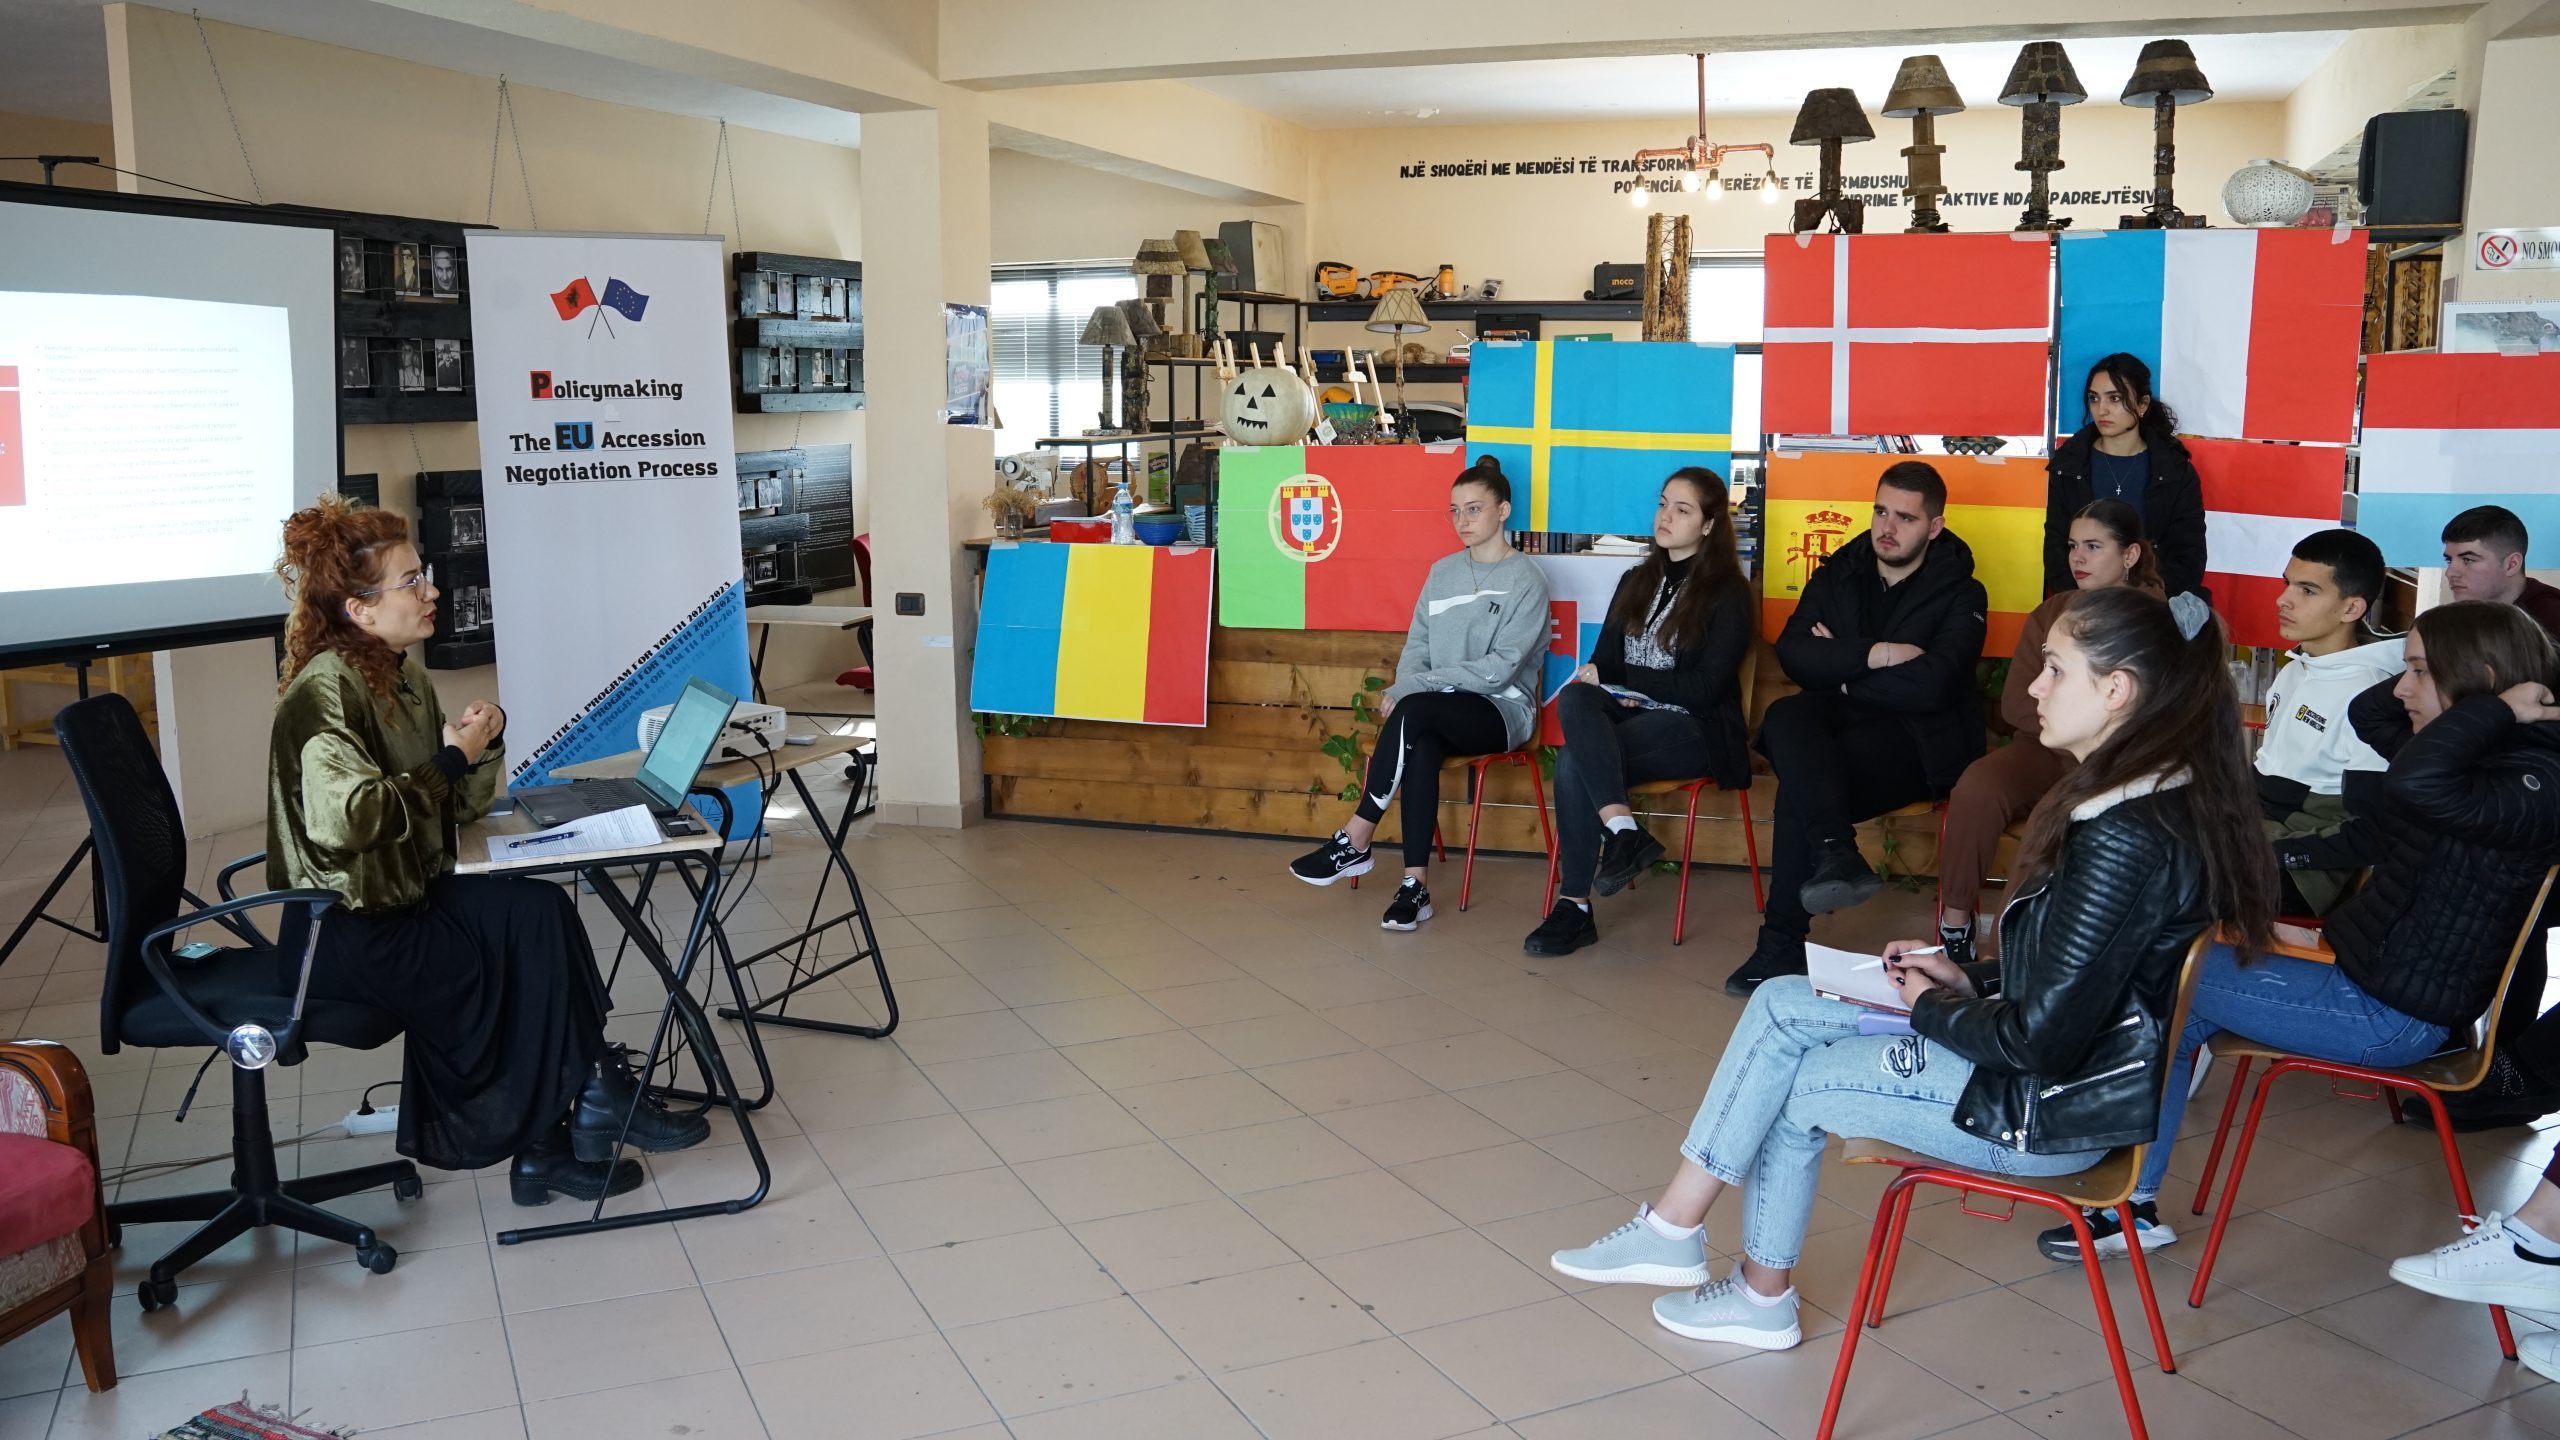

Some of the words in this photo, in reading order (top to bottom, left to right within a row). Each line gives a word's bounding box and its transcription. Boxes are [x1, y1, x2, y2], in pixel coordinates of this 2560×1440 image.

[1400, 160, 1425, 178] NJË
[1491, 162, 1511, 176] ME
[1579, 155, 1597, 173] TË
[1602, 157, 1693, 173] TRANSFORM
[1795, 171, 1814, 190] TË
[2003, 191, 2032, 206] NDA
[2049, 185, 2156, 205] PADREJTËSIV
[2521, 241, 2536, 260] NO
[2537, 240, 2560, 260] SMO
[531, 371, 683, 403] Policymaking
[509, 432, 551, 452] The
[555, 423, 594, 450] EU
[600, 428, 706, 450] Accession
[505, 461, 632, 486] Negotiation
[637, 460, 719, 479] Process
[511, 757, 534, 778] THE
[532, 713, 585, 759] POLITICAL
[584, 668, 633, 713] PROGRAM
[631, 649, 654, 671] FOR
[653, 620, 687, 651] YOUTH
[686, 581, 731, 622] 2022-2023
[589, 678, 639, 723] PROGRAM
[637, 659, 660, 681] FOR
[659, 630, 693, 661] YOUTH
